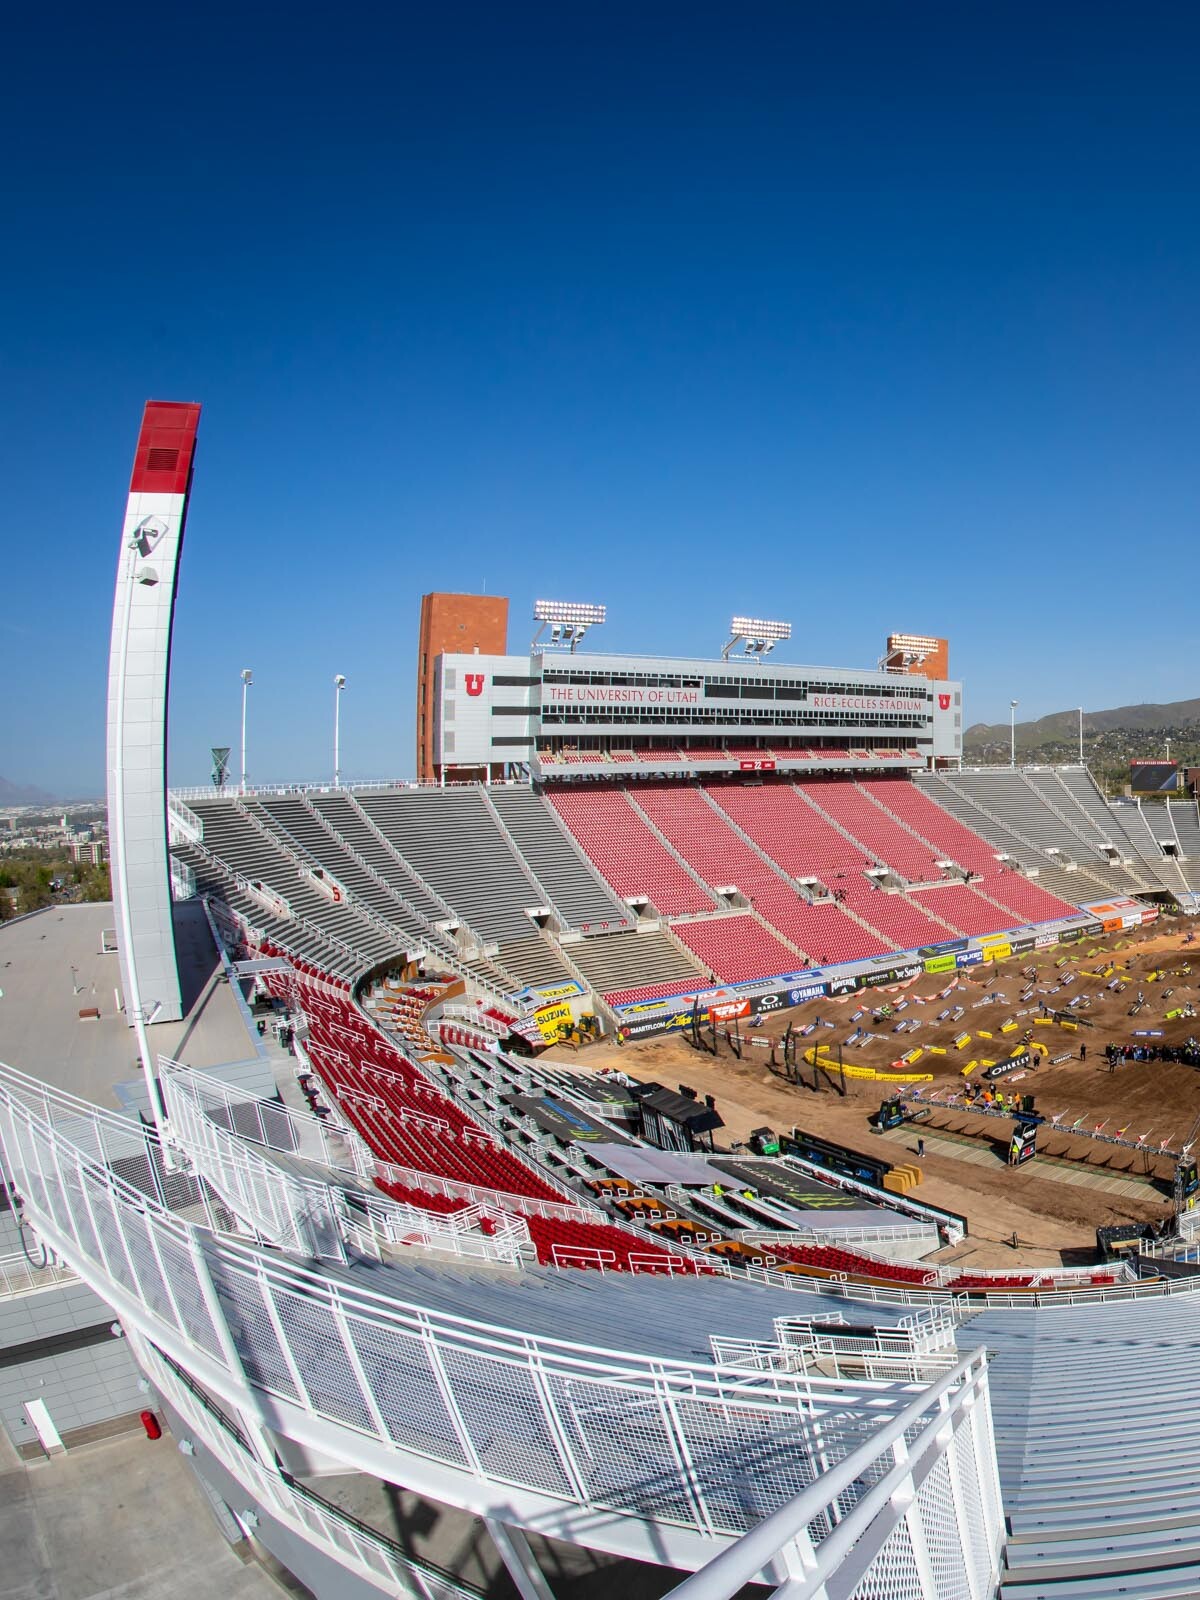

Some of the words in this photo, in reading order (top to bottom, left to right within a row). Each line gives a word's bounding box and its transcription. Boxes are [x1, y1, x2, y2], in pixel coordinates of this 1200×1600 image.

[465, 674, 485, 696] U
[550, 688, 573, 700] THE
[577, 689, 645, 701] UNIVERSITY
[648, 691, 664, 702] OF
[667, 692, 697, 703] UTAH
[814, 697, 877, 709] RICE-ECCLES
[879, 700, 922, 710] STADIUM
[798, 985, 825, 996] YAMAHA
[757, 1001, 783, 1012] OAKLEY
[537, 1008, 571, 1025] SUZUKI
